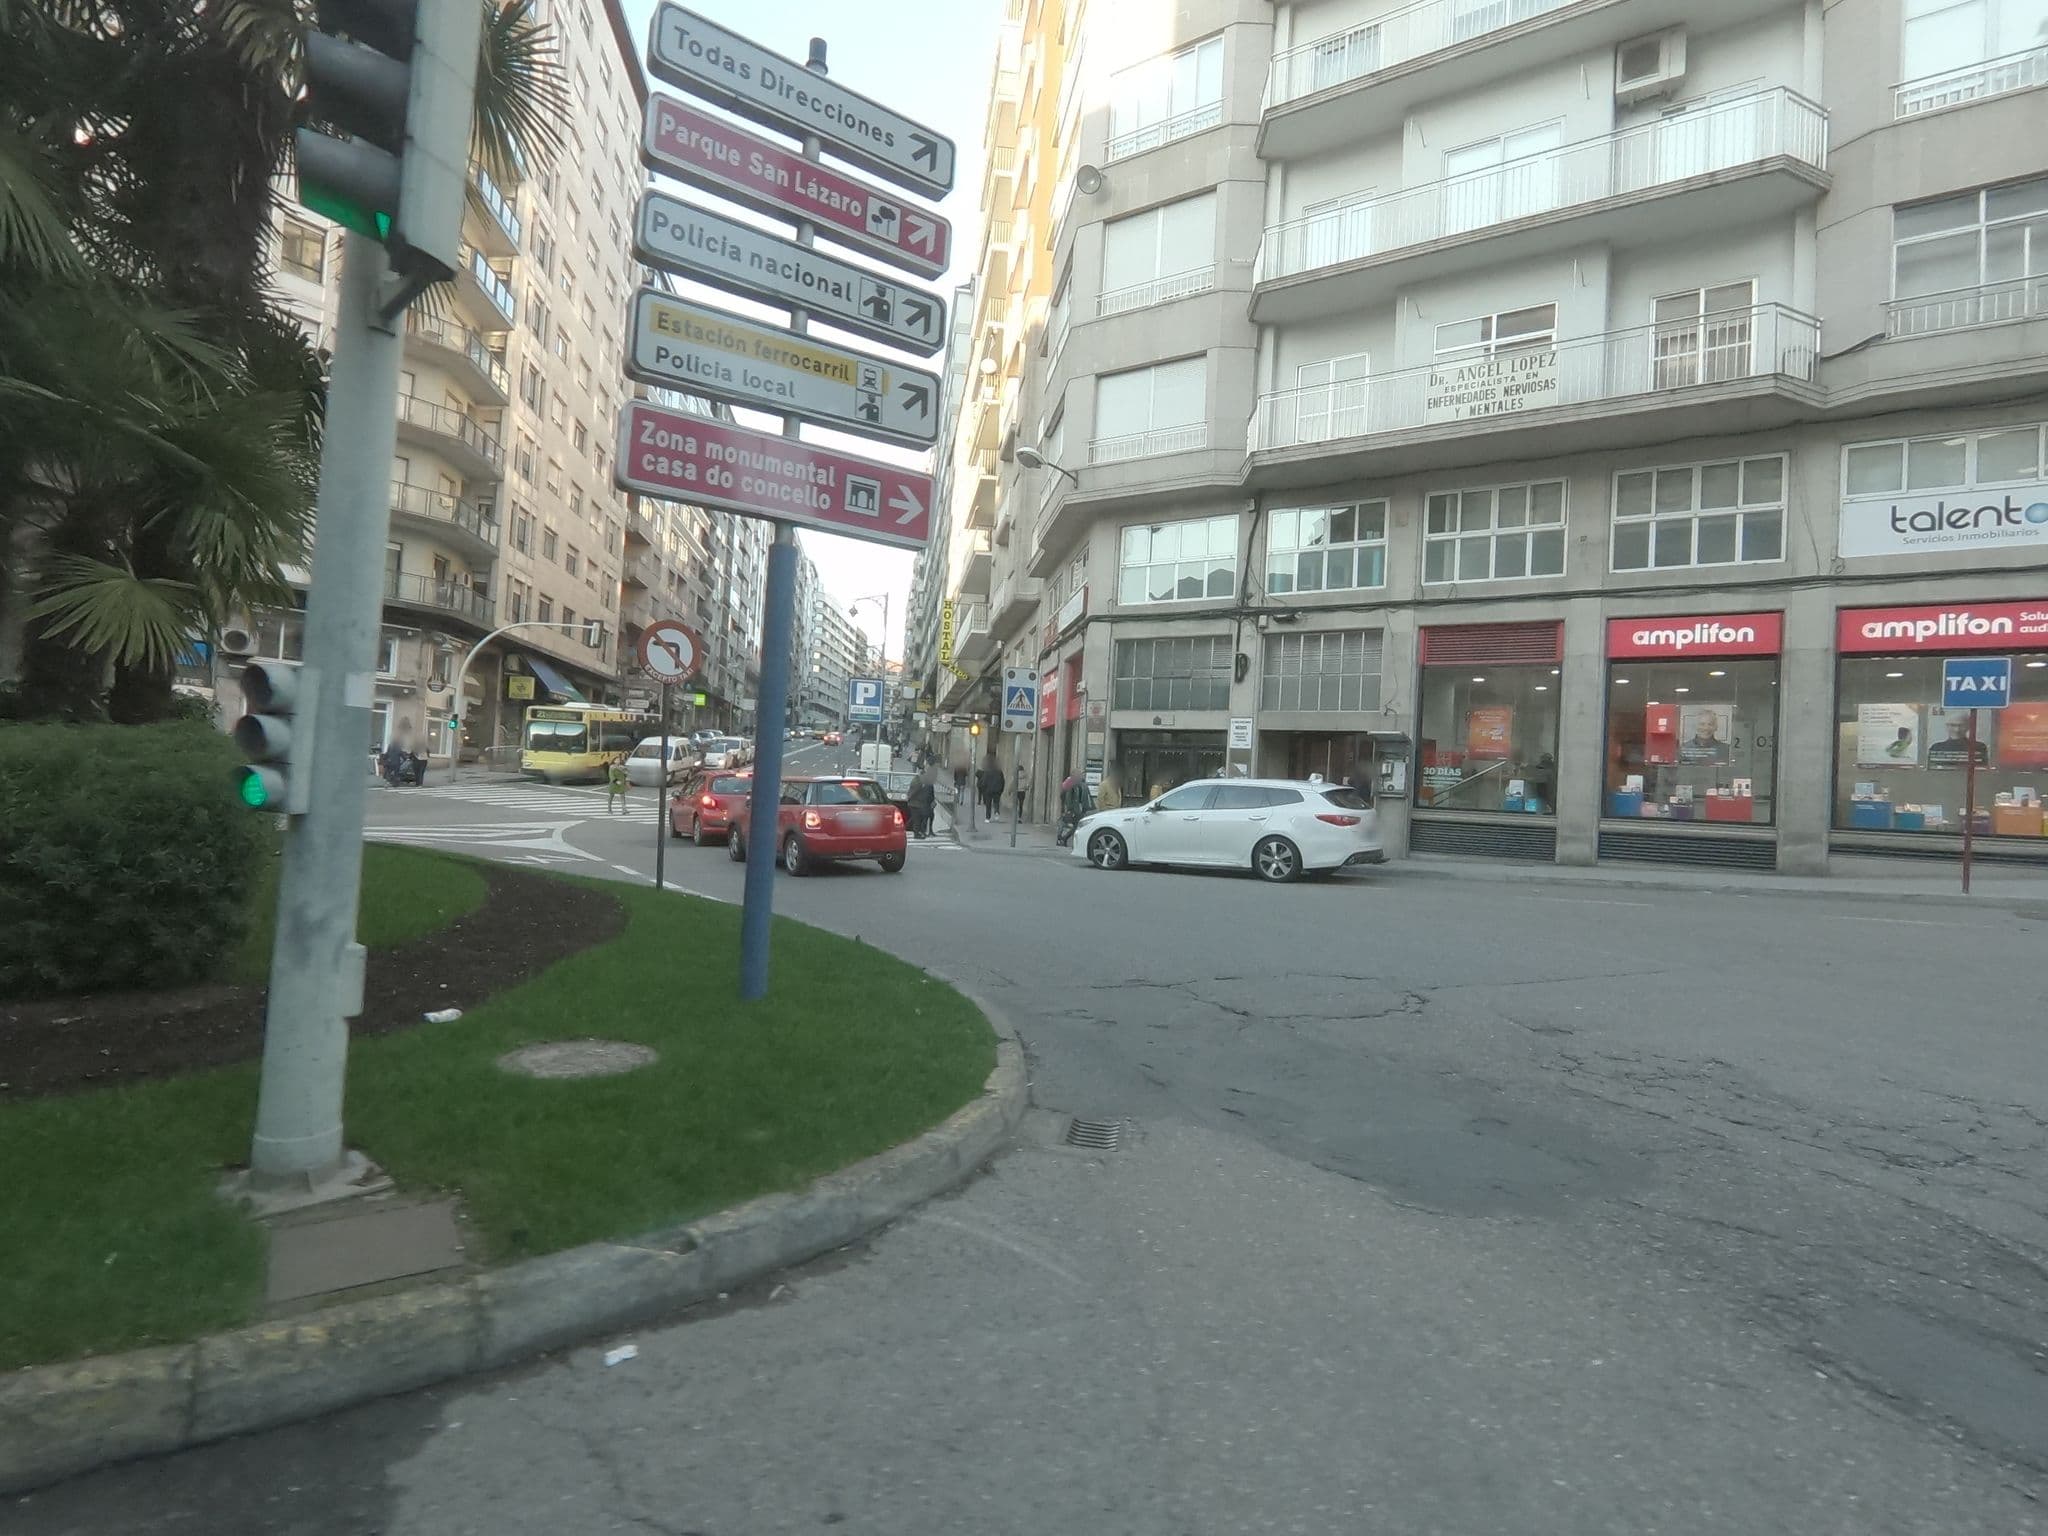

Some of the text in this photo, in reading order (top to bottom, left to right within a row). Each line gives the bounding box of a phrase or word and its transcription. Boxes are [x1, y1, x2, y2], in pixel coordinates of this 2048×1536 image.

[673, 25, 895, 148] Todas Direcciones
[660, 113, 862, 217] Parque San Lázaro
[751, 252, 853, 302] nacional
[753, 338, 849, 381] ferrocarril
[743, 369, 796, 398] local
[1427, 378, 1556, 409] ENFERMEDADES NERVIOSAS
[1444, 371, 1538, 393] ESPECIALISTA EN
[1455, 398, 1523, 418] Y MENTALES
[640, 421, 836, 487] Zona monumental
[641, 454, 832, 510] casa do concello
[1903, 528, 2040, 545] Servicios Inmobiliarios
[941, 600, 952, 660] HOSTAL
[1632, 622, 1755, 650] amplifon
[1861, 612, 2013, 643] amplifon
[855, 682, 876, 704] P
[1946, 675, 2006, 691] TAXI
